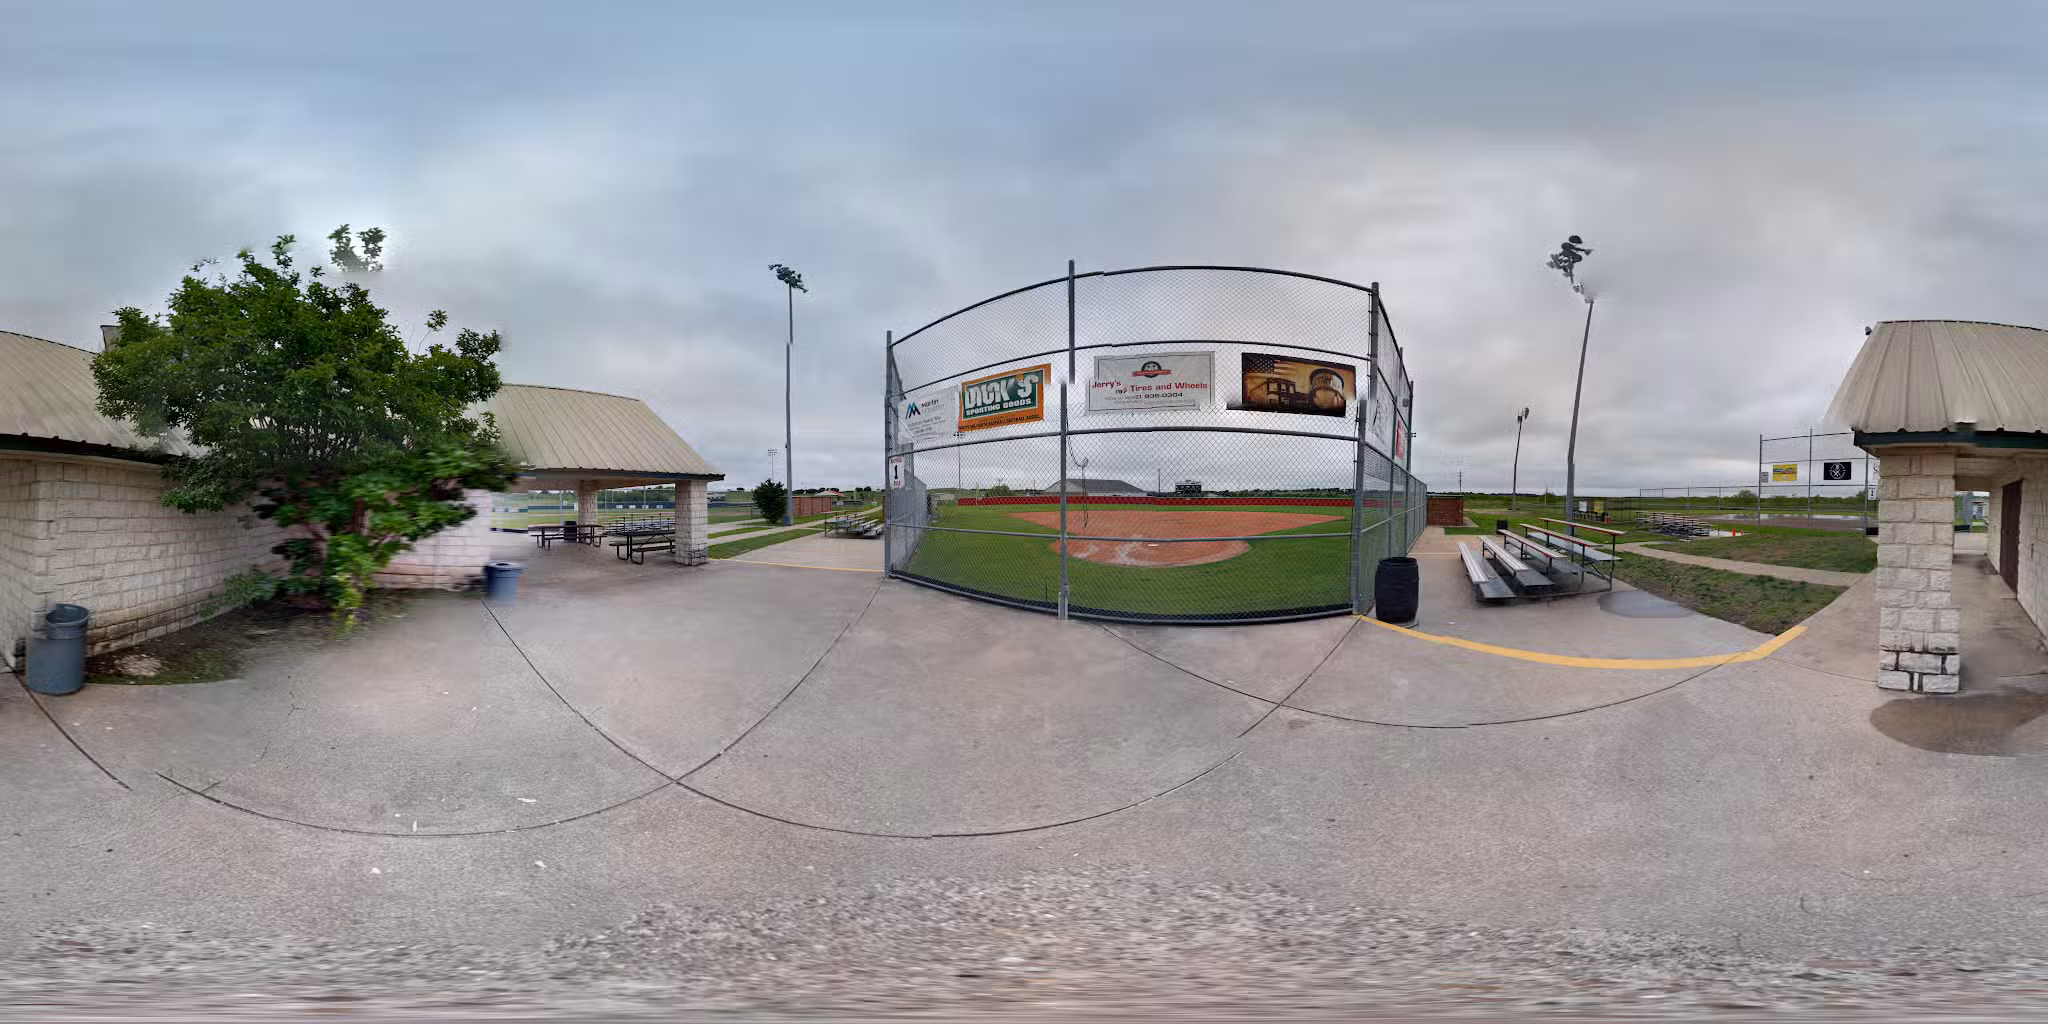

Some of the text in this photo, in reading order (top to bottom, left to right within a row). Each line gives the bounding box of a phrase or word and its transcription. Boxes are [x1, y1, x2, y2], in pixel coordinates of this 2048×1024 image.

[965, 375, 1039, 409] DICK'S
[1092, 380, 1121, 388] Jerry's
[1130, 384, 1152, 392] Tires
[921, 399, 939, 408] Martin
[966, 398, 1033, 416] SPORTING GOODS
[894, 464, 898, 480] 1
